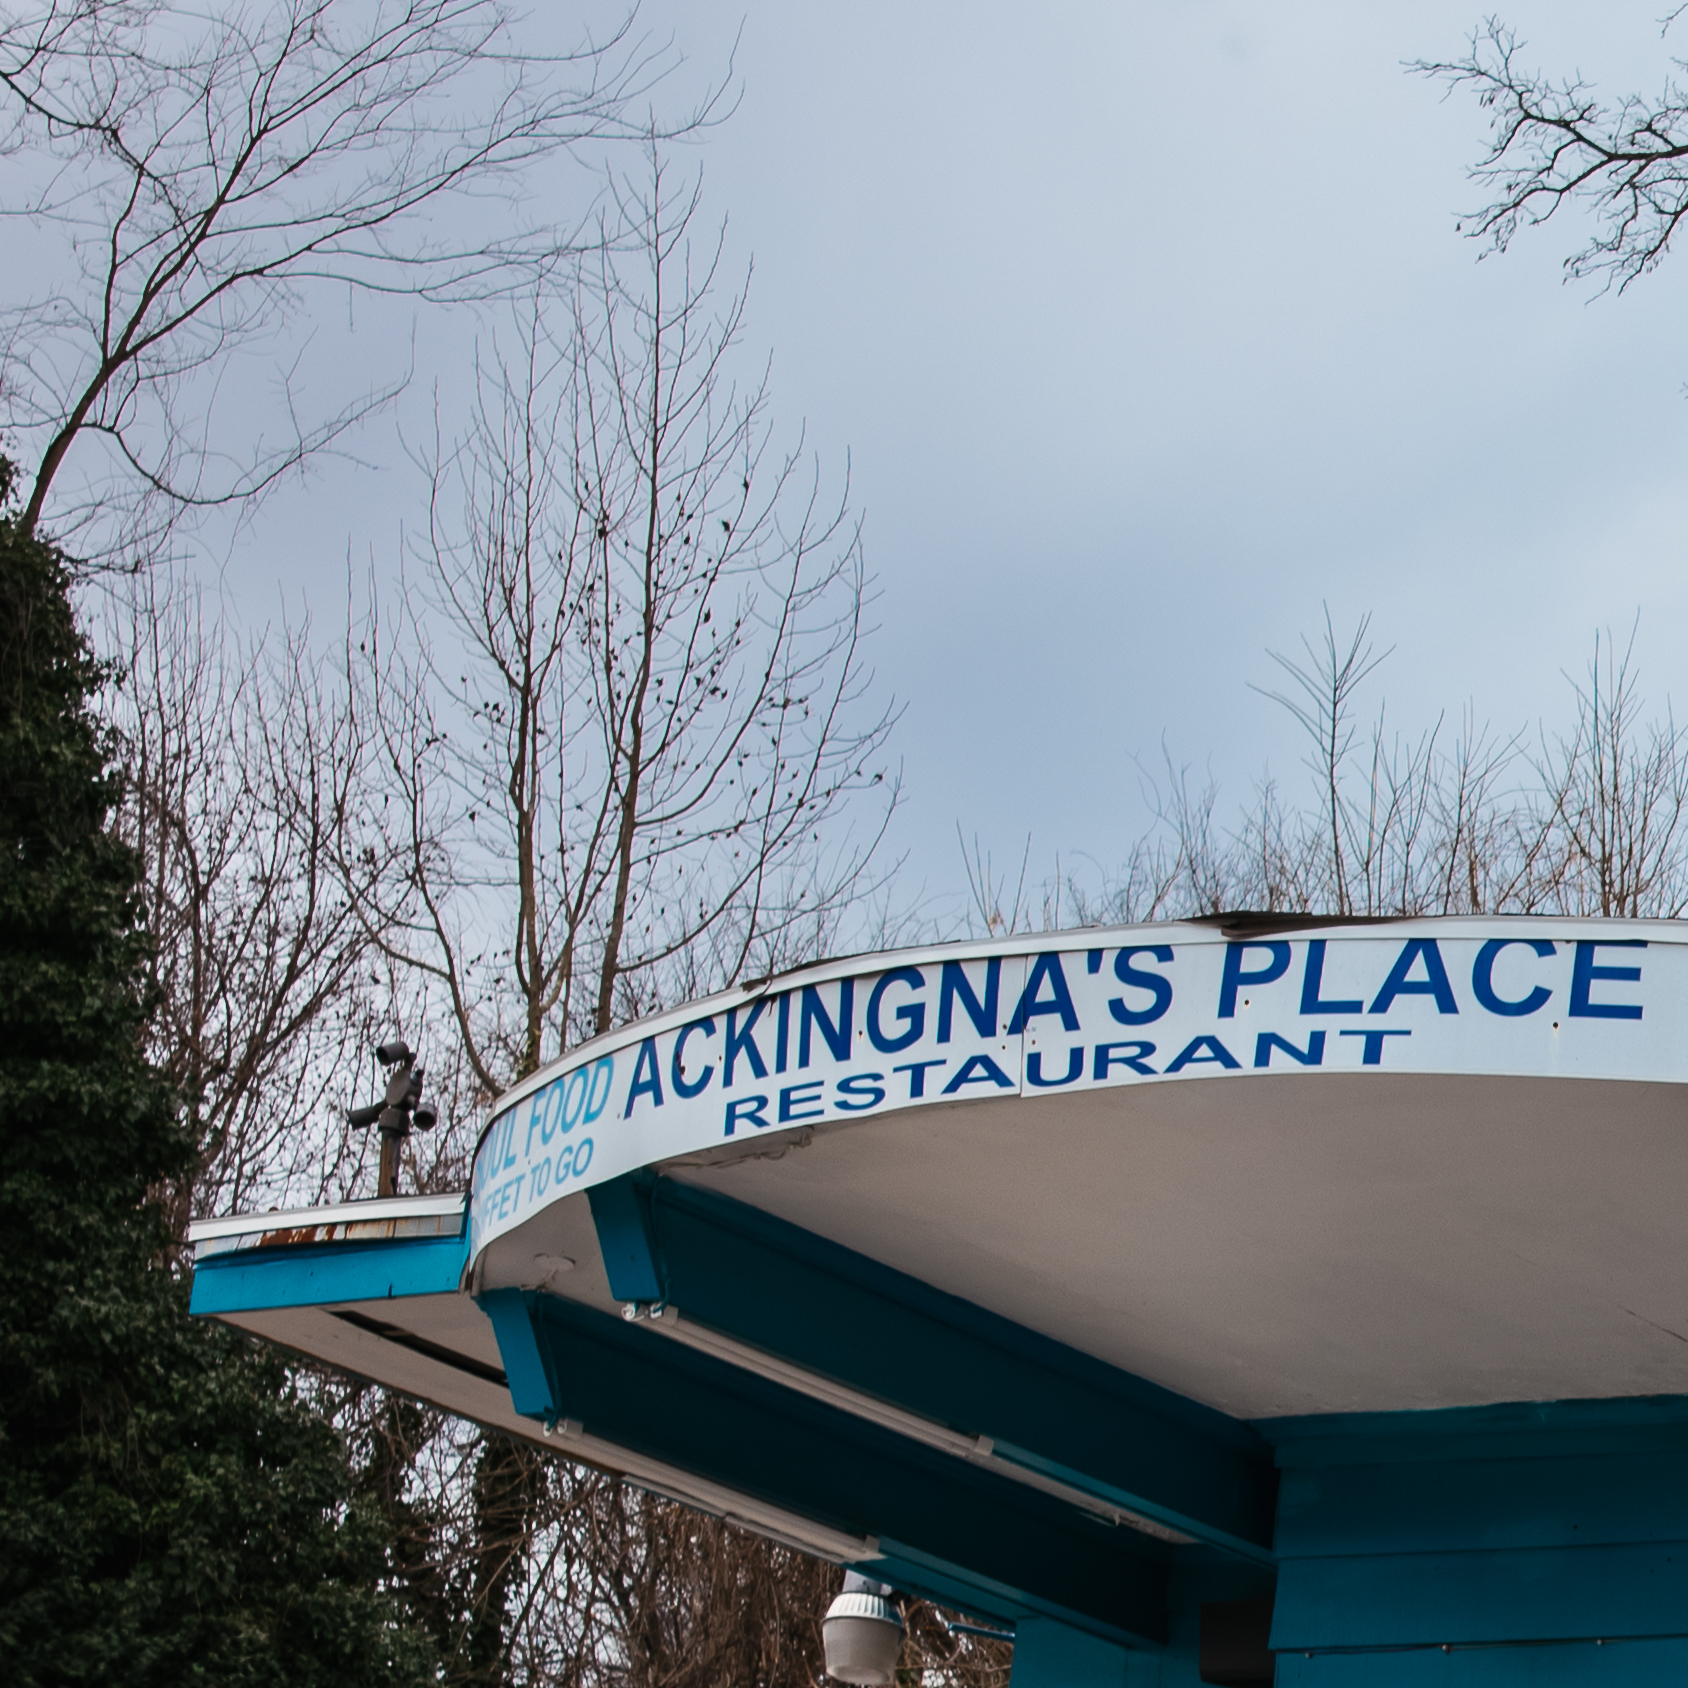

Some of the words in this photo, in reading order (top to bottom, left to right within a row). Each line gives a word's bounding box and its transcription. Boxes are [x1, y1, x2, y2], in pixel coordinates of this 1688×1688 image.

[622, 943, 1176, 1120] ACKINGNA'S
[1217, 938, 1649, 1020] PLACE
[525, 1055, 614, 1157] FOOD
[723, 1029, 1412, 1136] RESTAURANT
[529, 1157, 551, 1203] TO
[555, 1137, 594, 1185] GO
